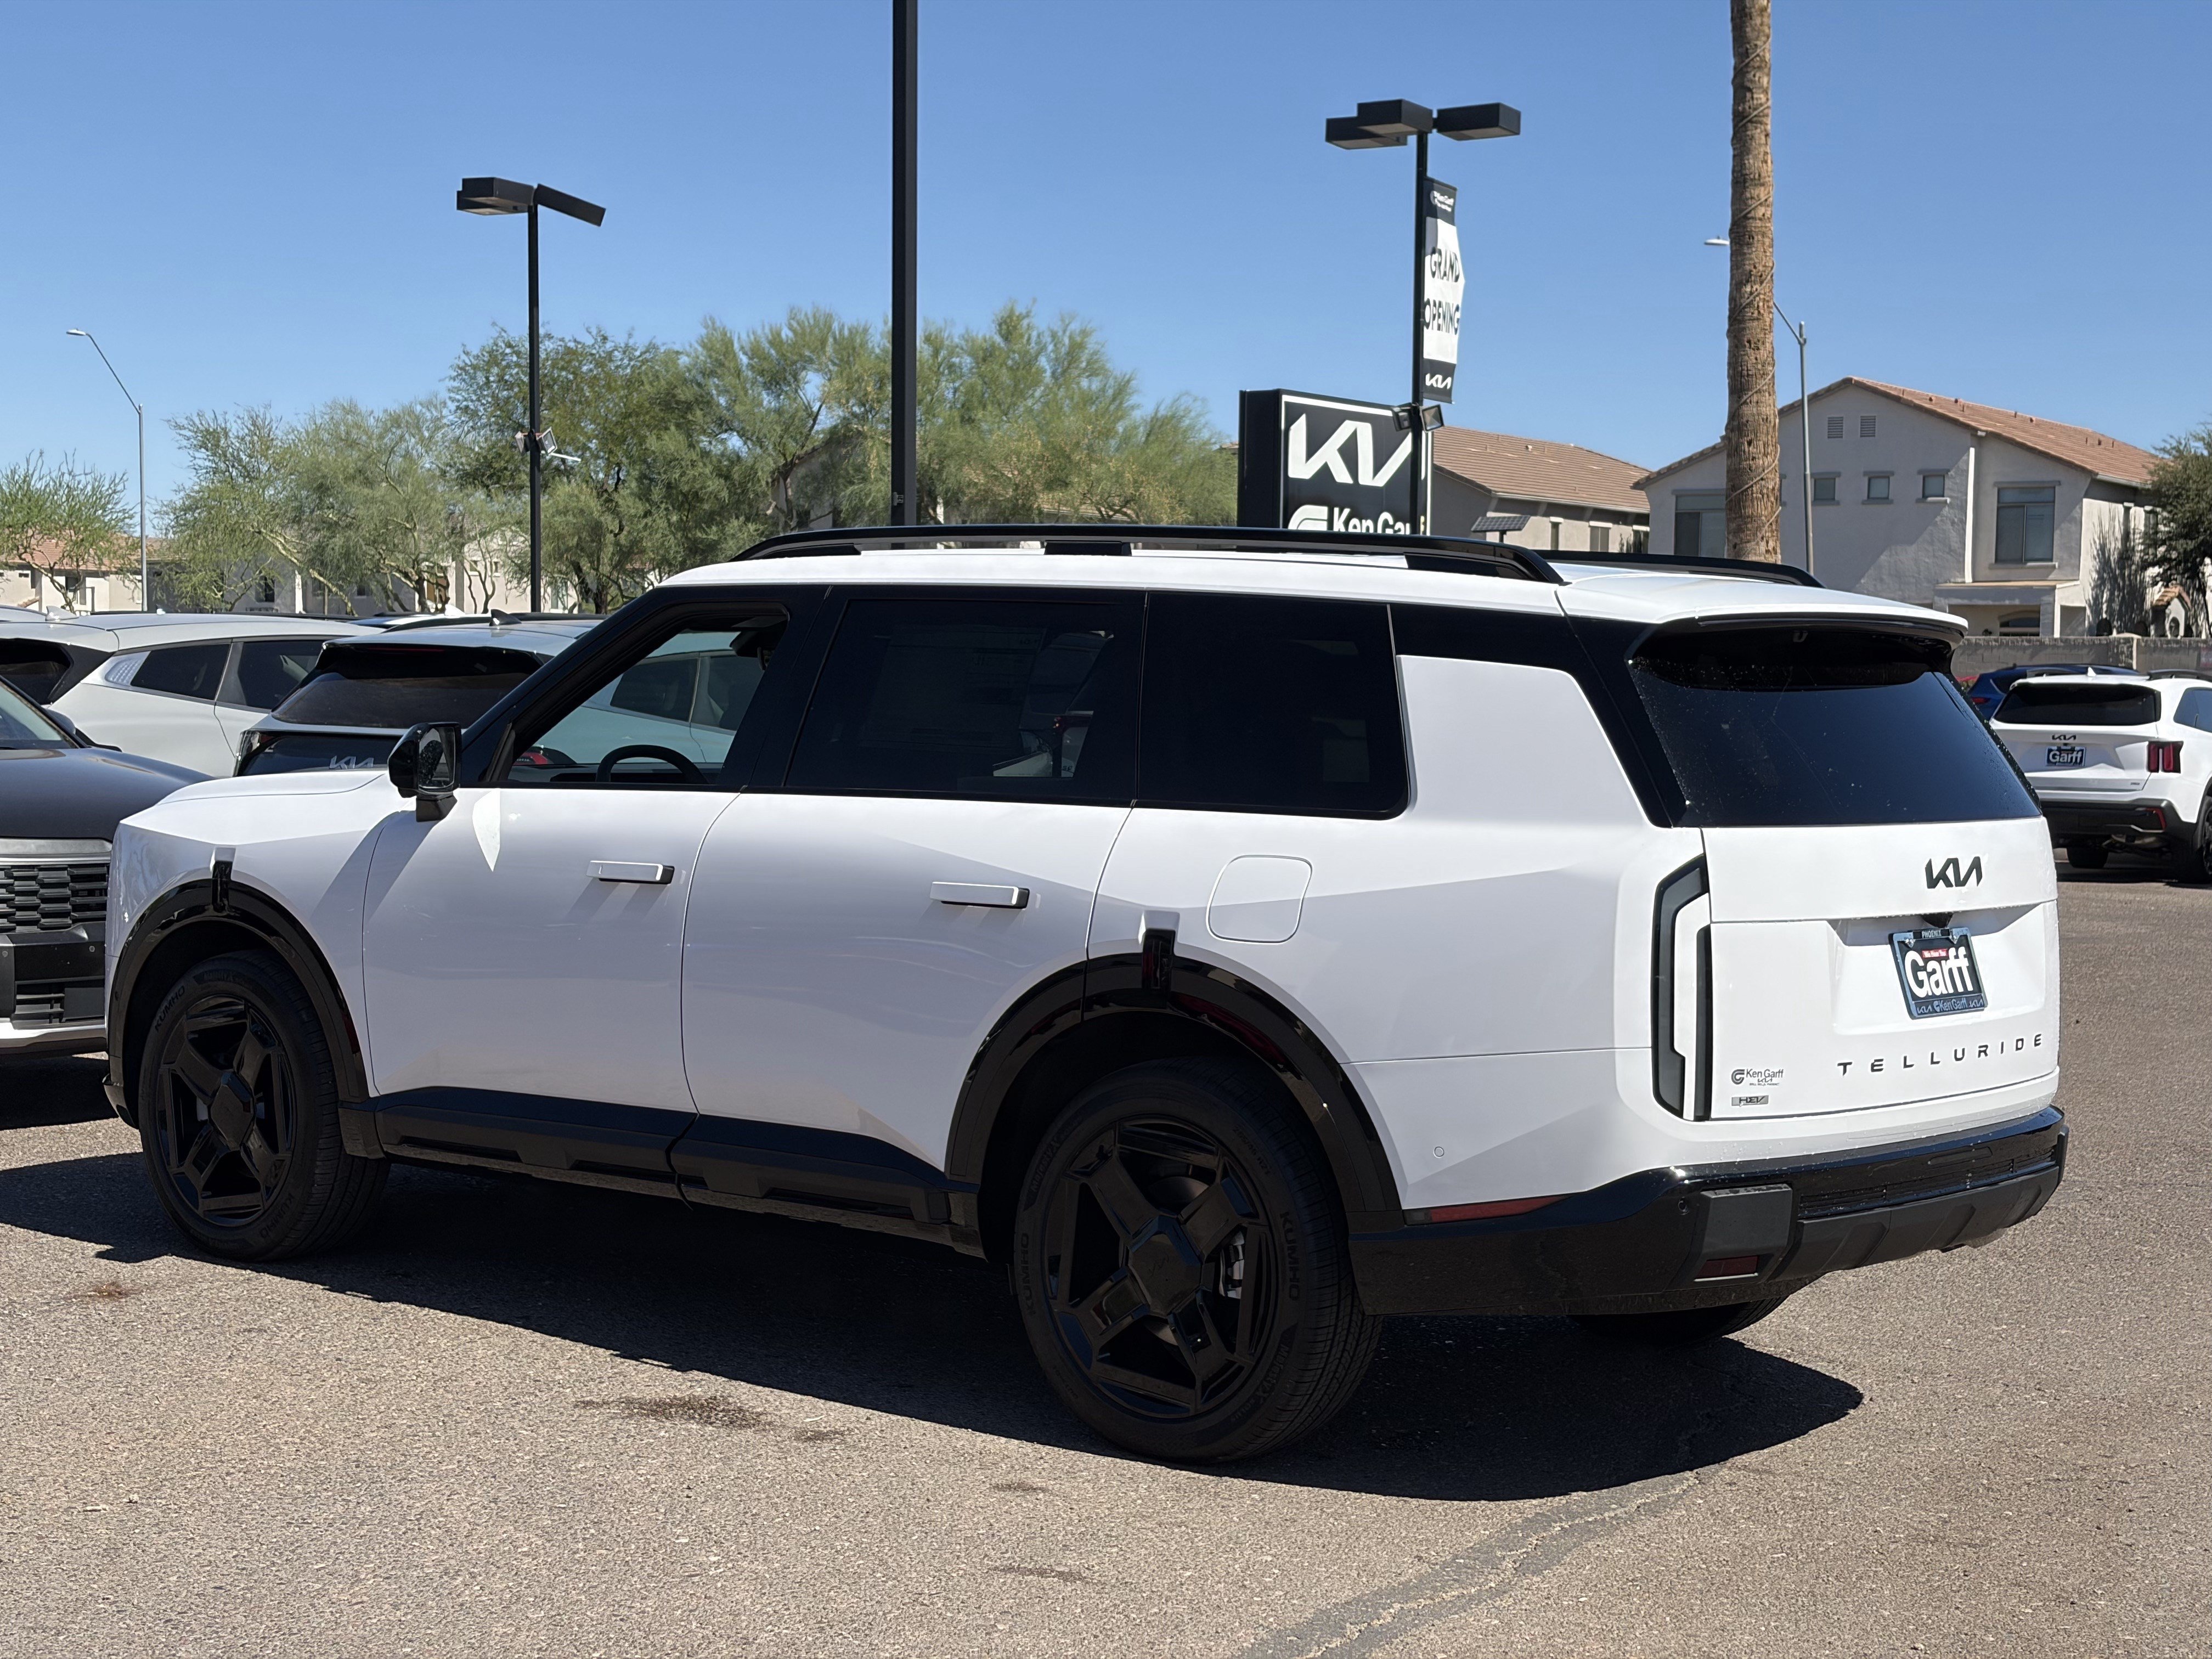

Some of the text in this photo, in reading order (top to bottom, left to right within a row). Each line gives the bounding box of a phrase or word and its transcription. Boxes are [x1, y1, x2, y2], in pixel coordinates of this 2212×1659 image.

[1430, 246, 1460, 283] GRAND
[1425, 298, 1460, 335] OPENING
[1425, 373, 1452, 389] KIA
[1333, 507, 1374, 533] Ken
[329, 755, 374, 770] KIA
[2049, 751, 2082, 764] Garff
[1925, 856, 1983, 889] KIA
[1921, 929, 1942, 939] PHOENIX
[1904, 946, 1973, 998] Garff
[1837, 1033, 2042, 1076] TELLURIDE
[1746, 1068, 1784, 1079] Ken Garff
[1279, 1211, 1300, 1301] KUMHO
[1020, 1232, 1036, 1316] KUMHO
